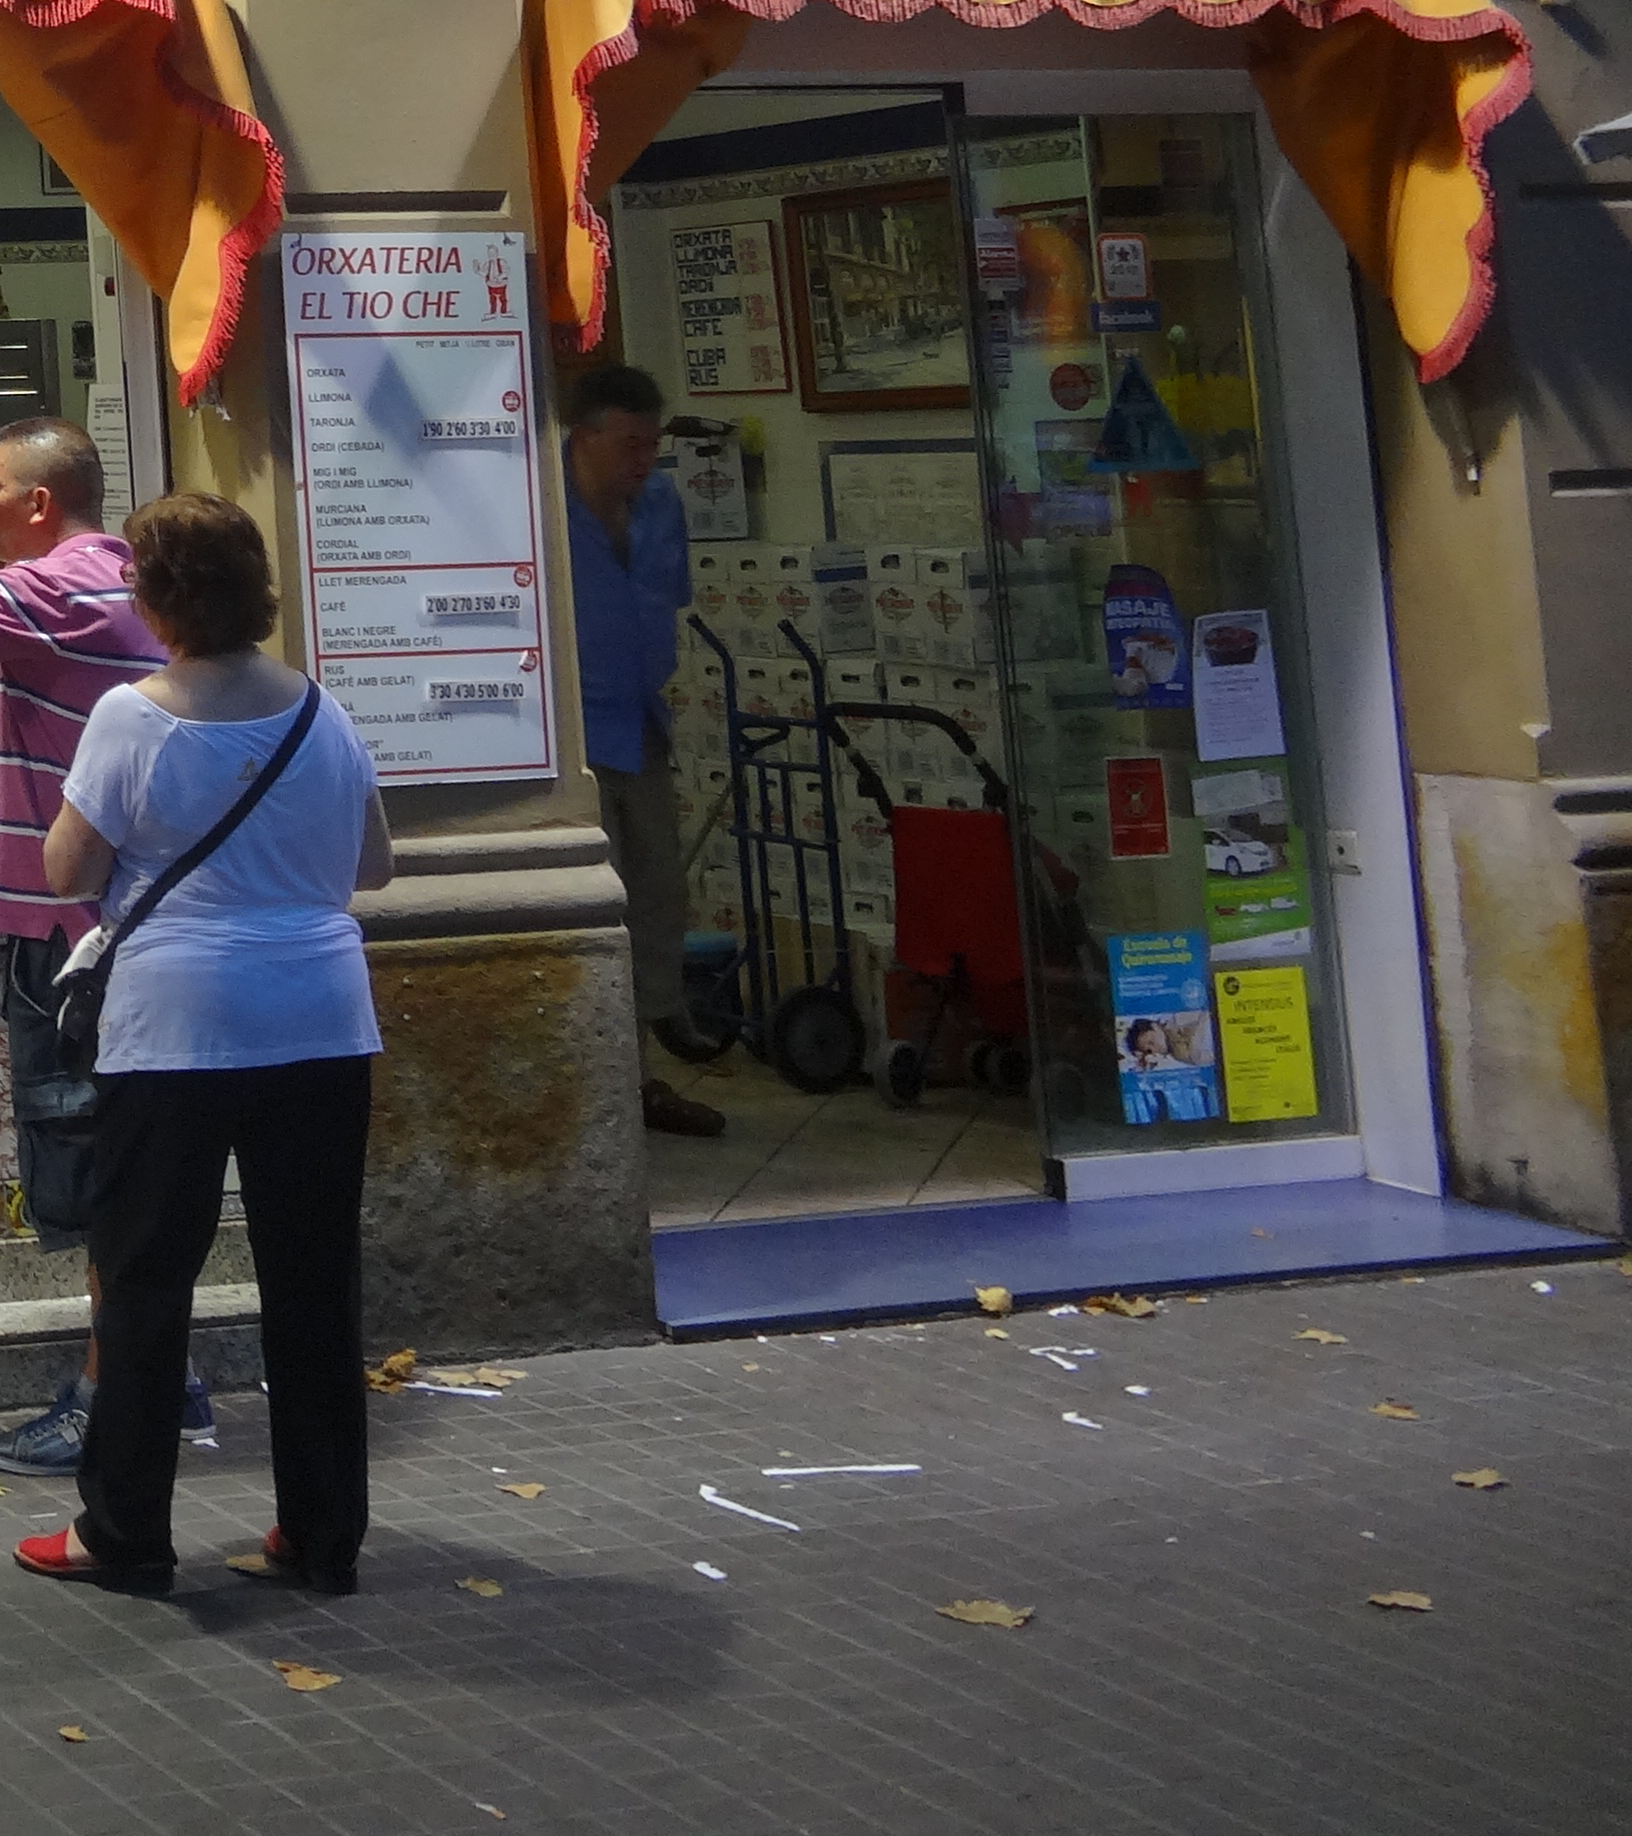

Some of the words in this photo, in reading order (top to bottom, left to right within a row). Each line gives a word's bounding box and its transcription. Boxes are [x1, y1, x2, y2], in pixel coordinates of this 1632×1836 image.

[291, 246, 462, 276] ORXATERIA
[300, 291, 333, 320] EL
[341, 291, 393, 320] TIO
[402, 290, 461, 319] CHE
[307, 367, 346, 378] ORXATA
[308, 392, 353, 403] LLIMONA
[309, 417, 356, 428] TARONJA
[311, 443, 335, 453] ORDI
[367, 477, 414, 490] LLIMONA)
[315, 504, 367, 515] MURCIANA
[316, 539, 359, 550] CORDIAL
[318, 577, 343, 587] LLET
[344, 575, 407, 586] MERENGADA
[322, 627, 355, 638] BLANC
[362, 625, 396, 636] NEGRE
[323, 638, 387, 652] (MERENGADA
